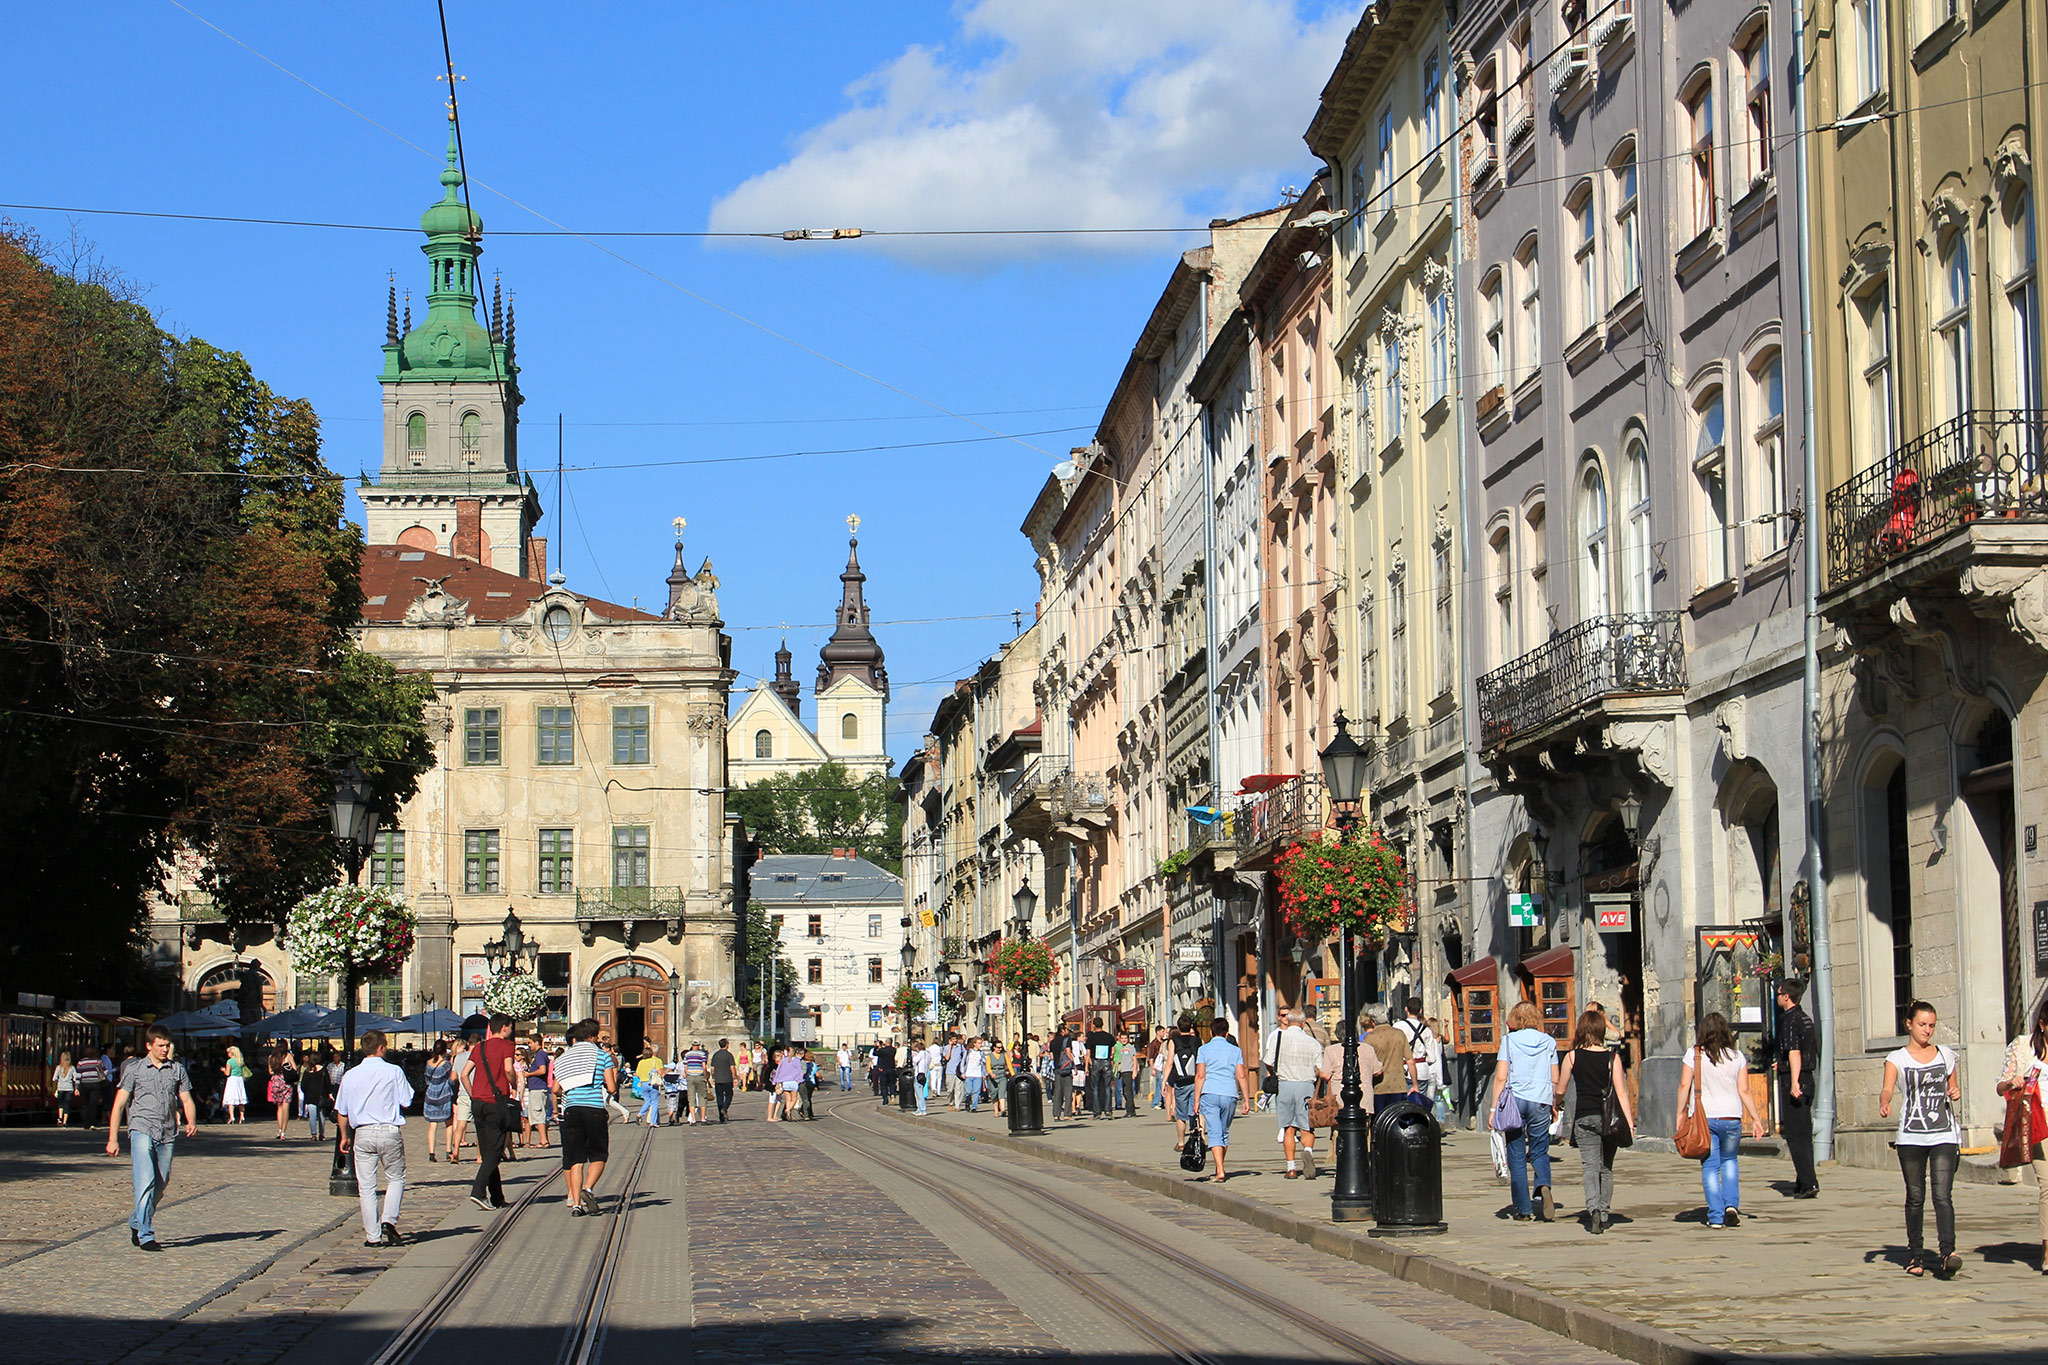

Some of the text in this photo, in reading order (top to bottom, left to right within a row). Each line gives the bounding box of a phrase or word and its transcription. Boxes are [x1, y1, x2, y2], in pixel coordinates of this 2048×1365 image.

[2025, 827, 2034, 846] 19
[1600, 913, 1626, 924] AVE
[465, 958, 486, 966] INFO
